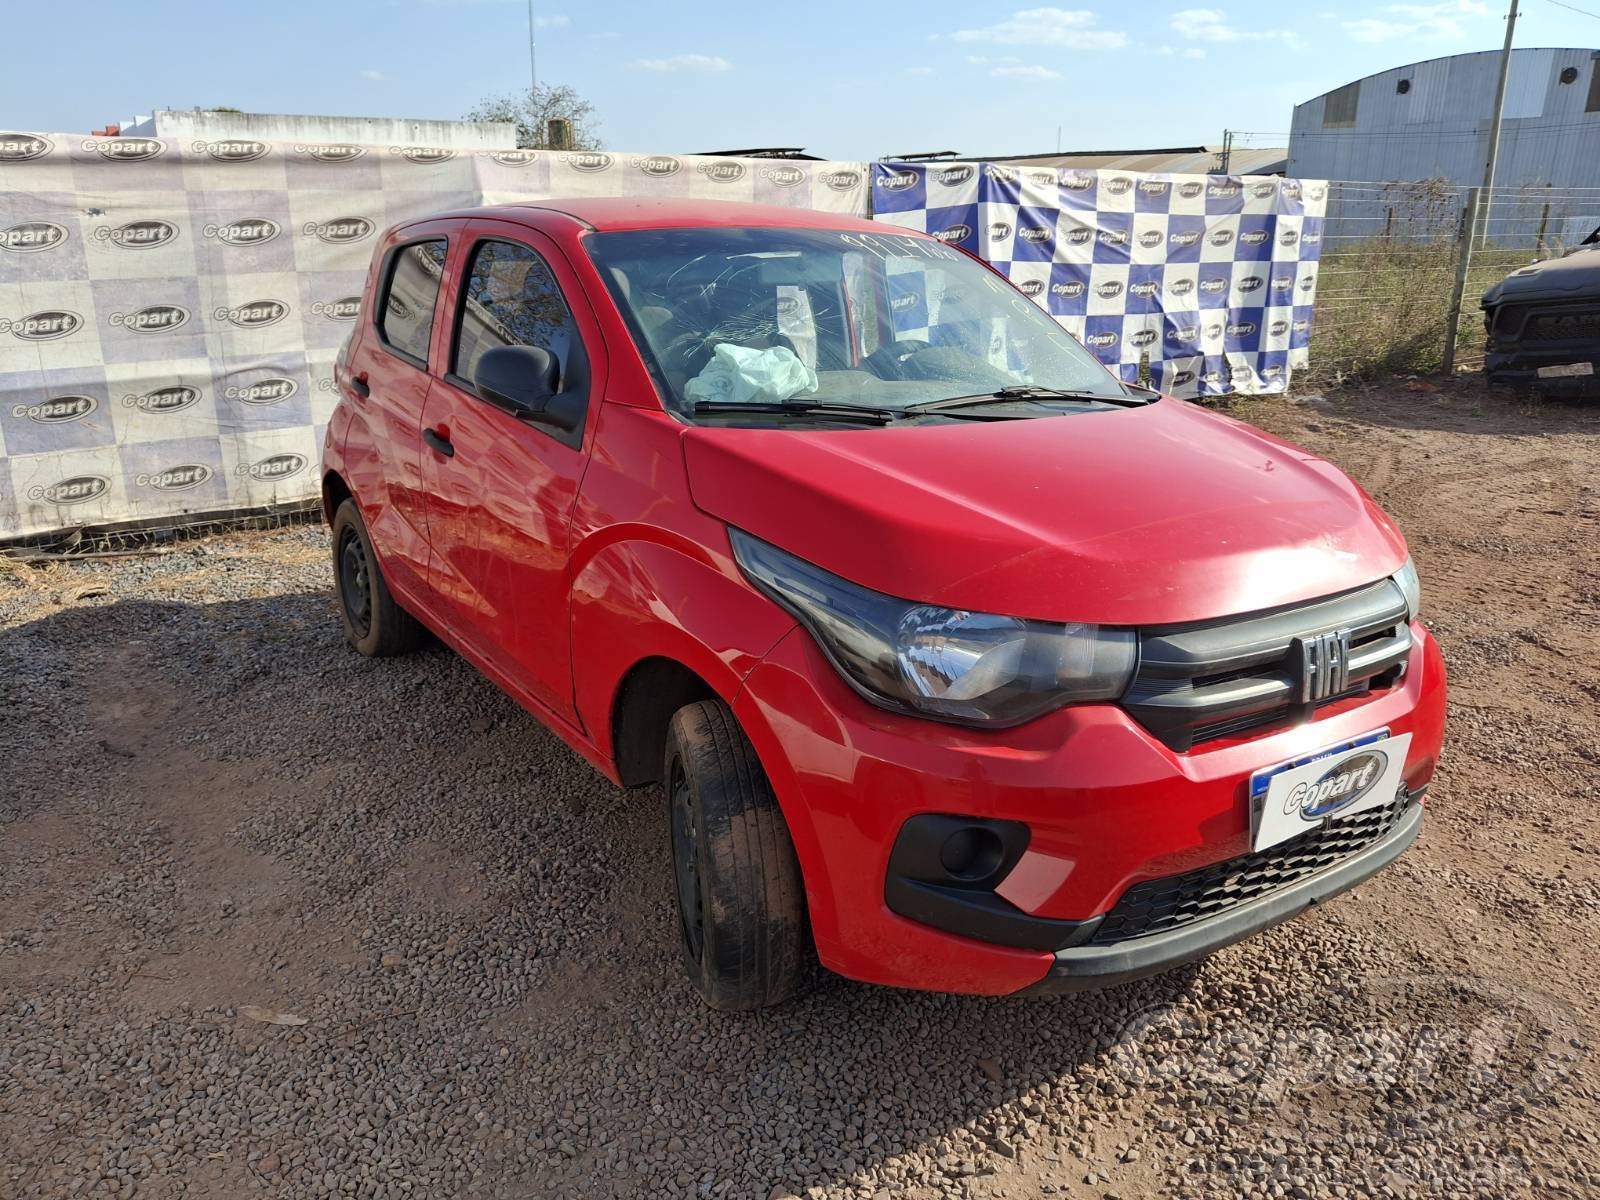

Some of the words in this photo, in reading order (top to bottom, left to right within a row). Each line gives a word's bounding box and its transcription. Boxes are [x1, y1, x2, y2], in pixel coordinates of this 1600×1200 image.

[82, 139, 155, 155] Copart
[192, 140, 260, 155] Copart
[631, 157, 676, 171] Copart
[697, 162, 740, 177] Copart
[760, 167, 799, 181] Copart
[819, 172, 856, 186] Copart
[877, 173, 914, 188] Copart
[94, 224, 168, 243] Copart
[203, 221, 270, 240] Copart
[303, 221, 365, 239] Copart
[932, 228, 966, 240] Copart
[1170, 233, 1199, 243] Copart
[1240, 232, 1265, 243] Copart
[1052, 283, 1081, 295] Copart
[1130, 283, 1156, 294] Copart
[109, 309, 180, 328] Copart
[214, 303, 281, 322] Copart
[0, 314, 72, 335] Copart
[1087, 334, 1115, 344] Copart
[122, 389, 191, 409] Copart
[225, 381, 289, 401] Copart
[12, 398, 86, 419] Copart
[235, 457, 300, 478] Copart
[135, 466, 204, 488] Copart
[28, 478, 100, 500] Copart
[1302, 630, 1352, 704] FIAT
[1283, 756, 1377, 816] Copart
